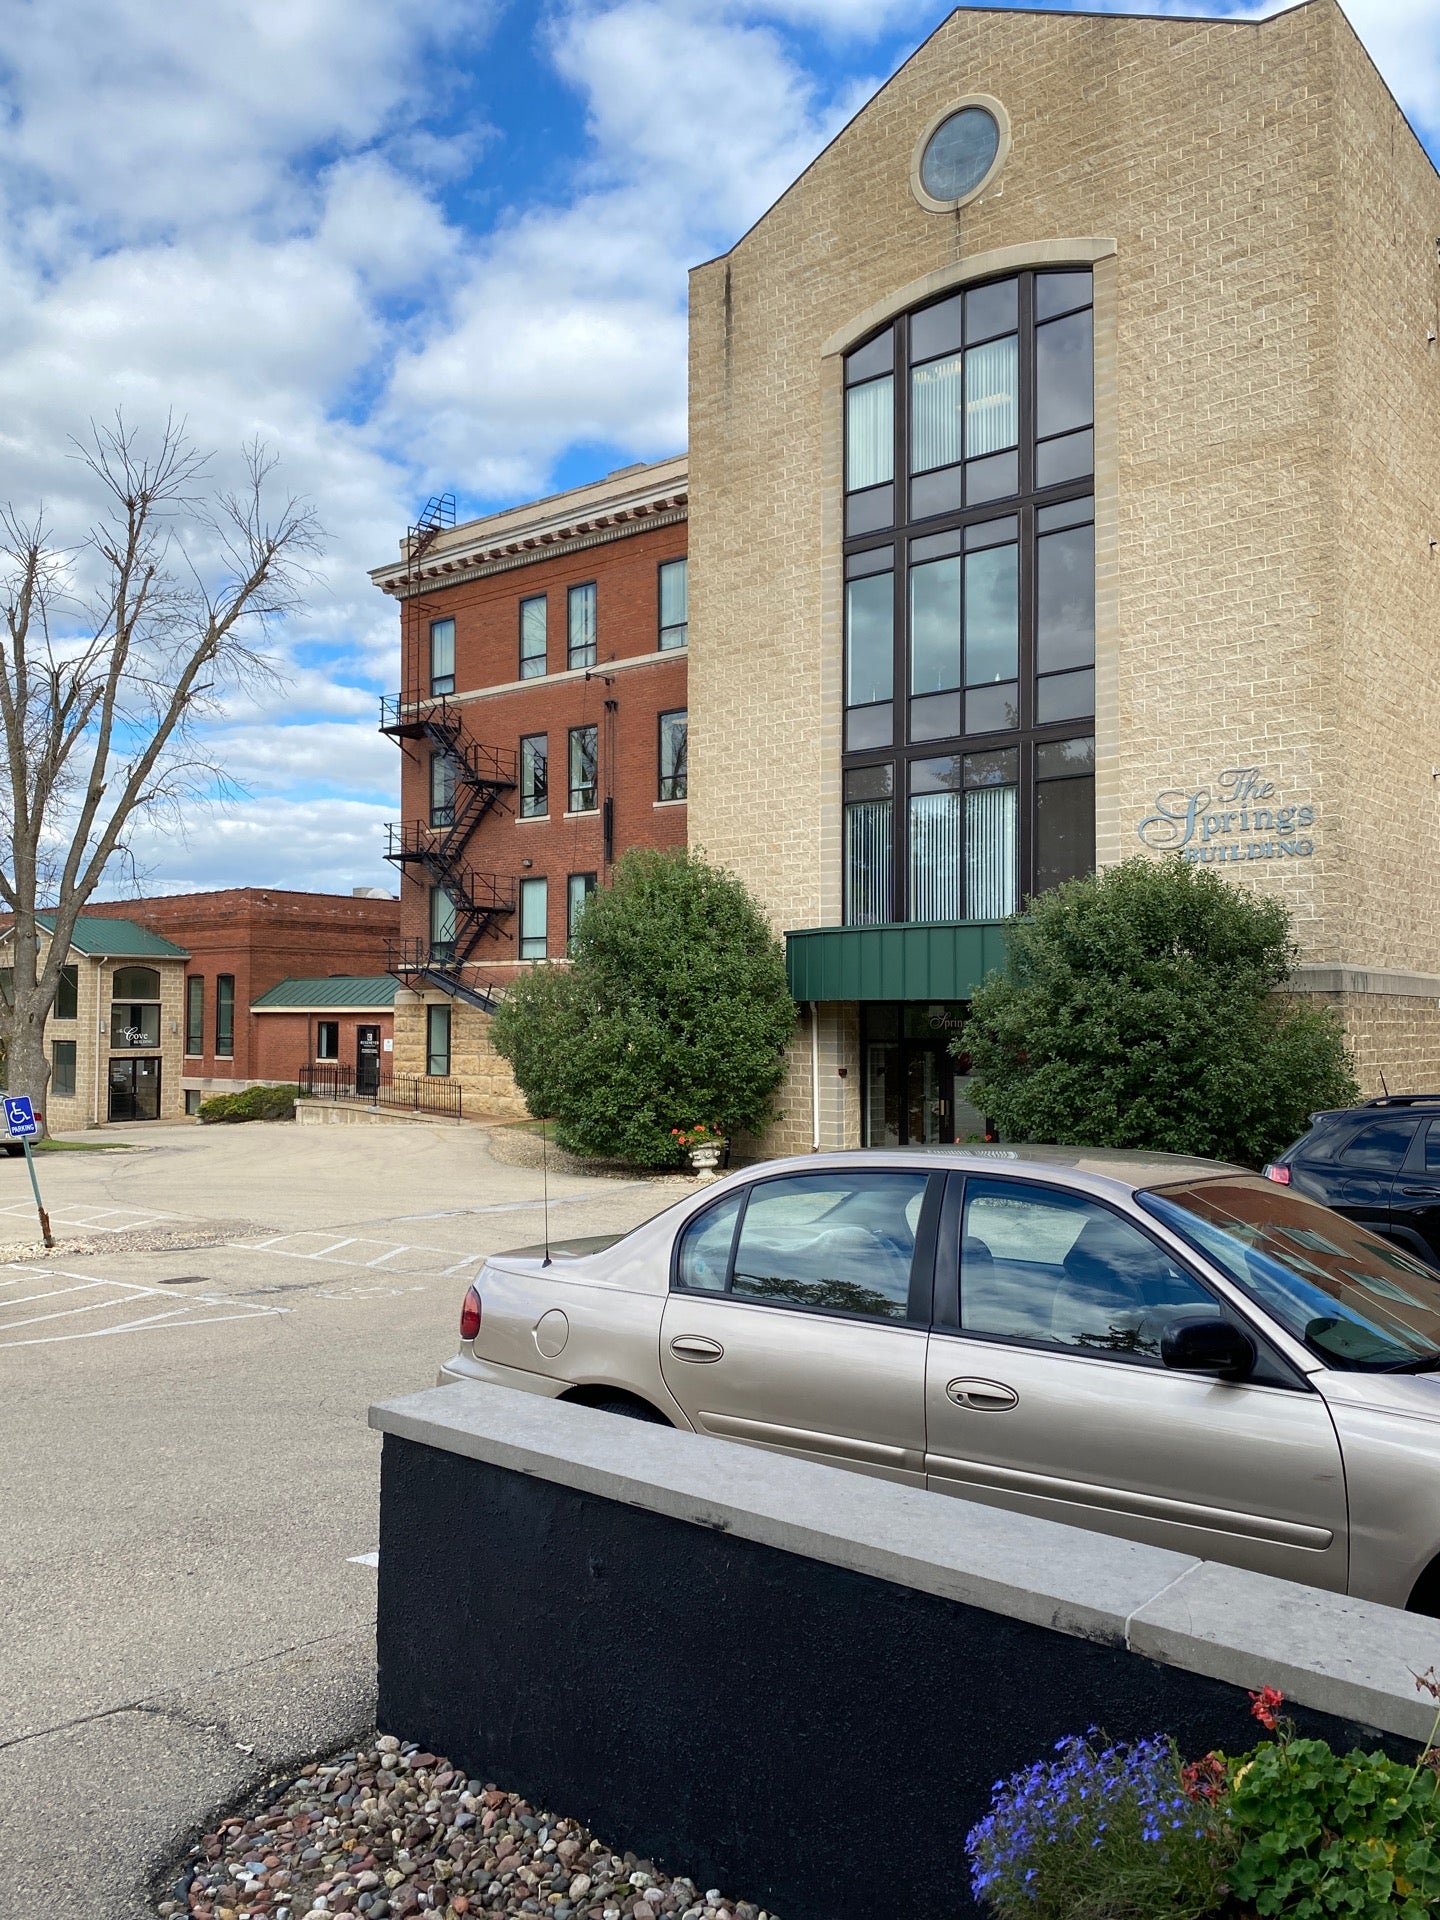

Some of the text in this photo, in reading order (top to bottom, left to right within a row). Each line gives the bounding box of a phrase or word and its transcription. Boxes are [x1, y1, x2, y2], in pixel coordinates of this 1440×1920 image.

[1218, 766, 1275, 802] The
[1138, 790, 1315, 850] Springs
[1184, 839, 1314, 864] BUILDING
[929, 1011, 967, 1030] Sprin
[123, 1026, 149, 1041] Cove
[11, 1123, 35, 1134] PARKING
